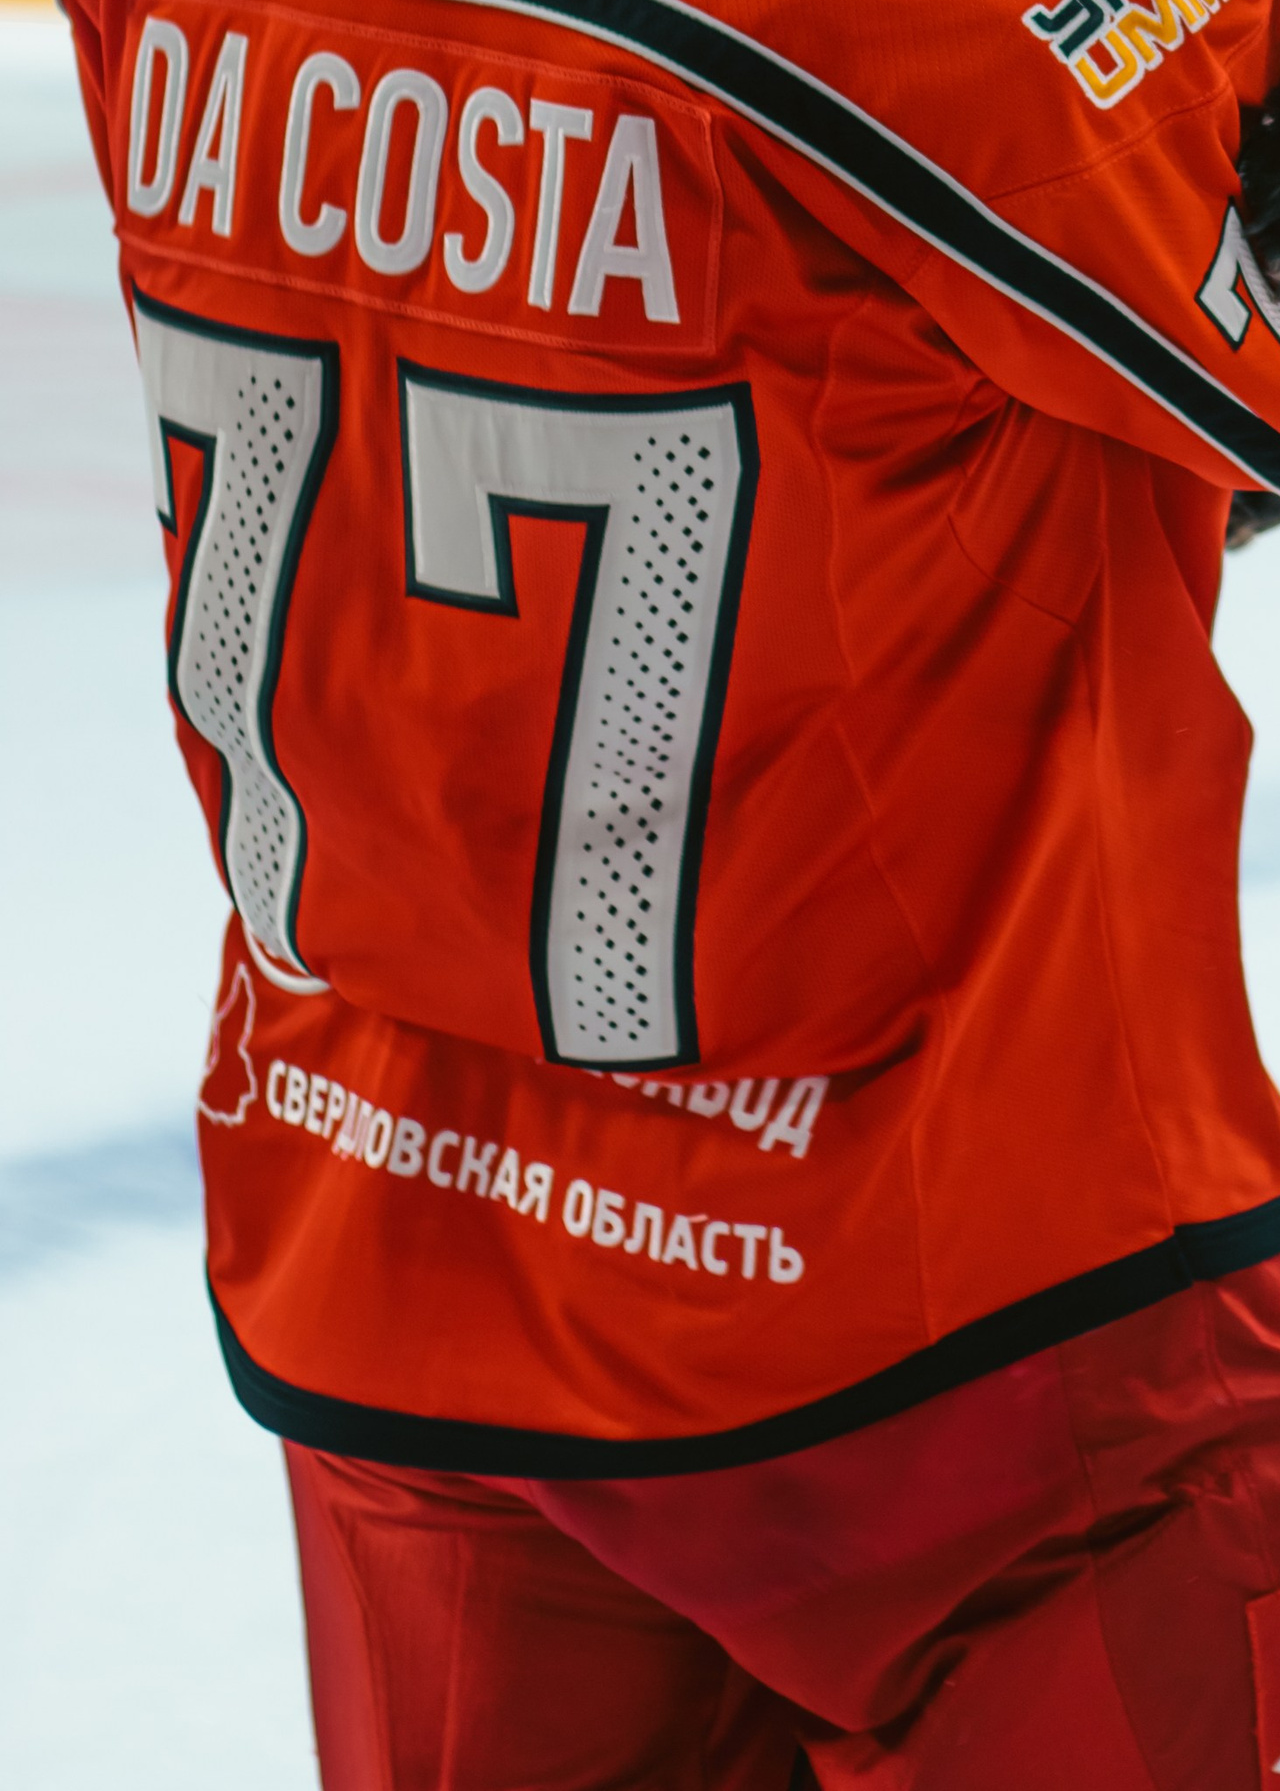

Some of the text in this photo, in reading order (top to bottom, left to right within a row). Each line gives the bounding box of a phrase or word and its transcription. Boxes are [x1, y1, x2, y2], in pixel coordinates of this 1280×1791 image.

[127, 16, 681, 325] DA COSTA
[131, 281, 760, 1071] 77
[562, 1178, 805, 1285] ОБЛАСТЬ
